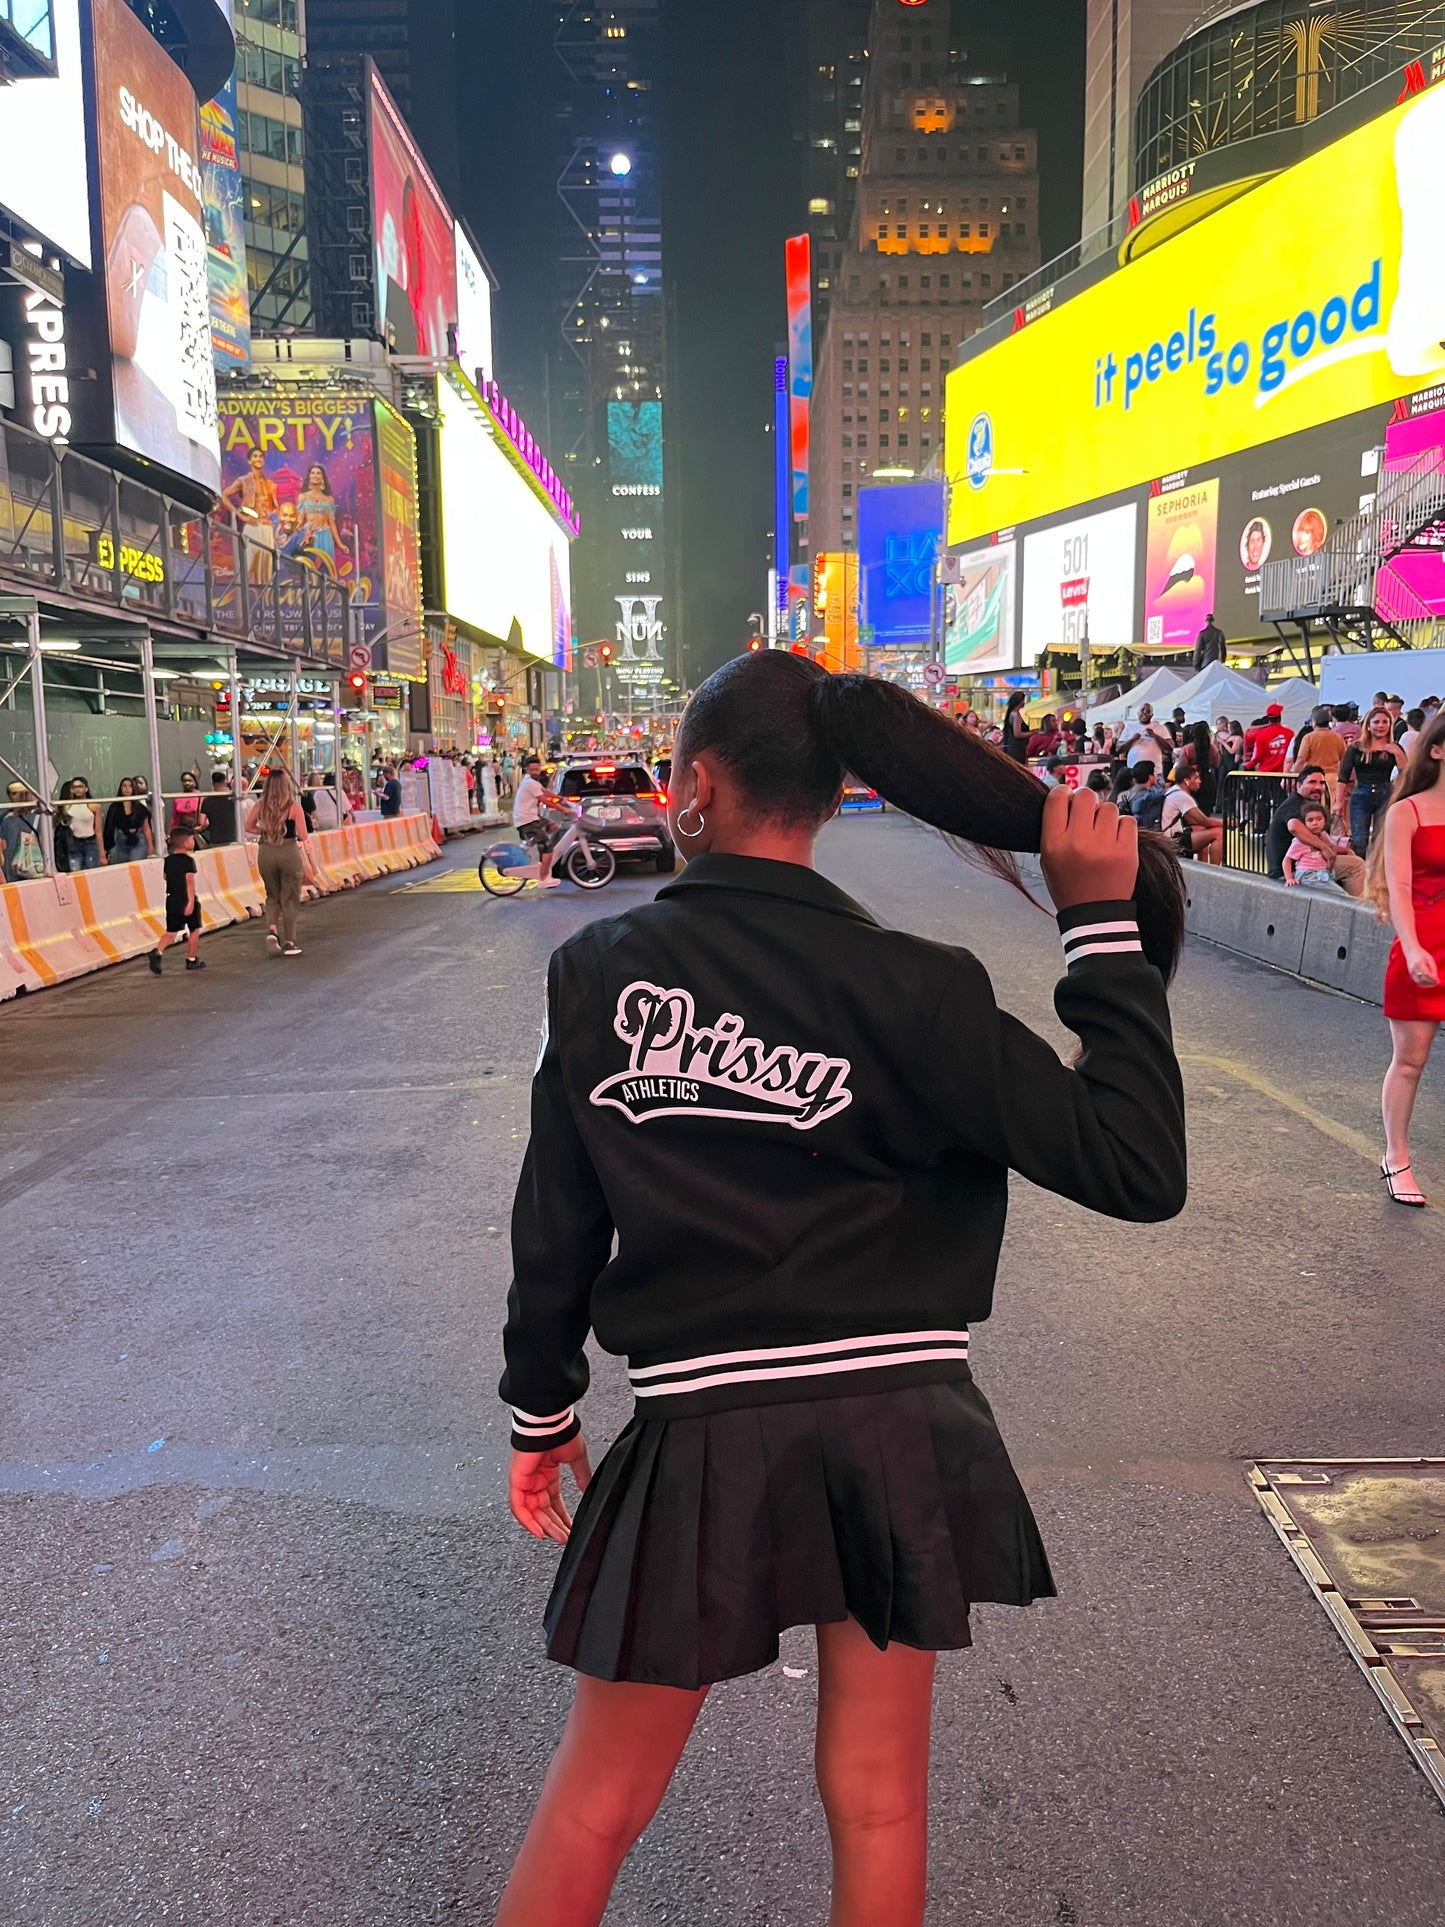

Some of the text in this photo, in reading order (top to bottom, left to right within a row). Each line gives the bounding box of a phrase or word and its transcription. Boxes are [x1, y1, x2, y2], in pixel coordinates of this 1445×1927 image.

[119, 85, 165, 155] SHOP
[165, 131, 194, 191] THE
[200, 119, 236, 158] TURE
[1142, 162, 1196, 201] MARRIOTT
[1142, 181, 1188, 216] MARQUIS
[1204, 256, 1382, 396] so good
[26, 292, 72, 446] PRES
[1095, 306, 1217, 412] it peels
[217, 399, 368, 416] ADWAY'S BIGGEST
[1411, 385, 1445, 405] MARRIO
[612, 484, 661, 496] CONFESS
[1251, 474, 1321, 502] Featuring Special Guests
[621, 528, 653, 540] YOUR
[1063, 533, 1089, 576] 501
[625, 571, 651, 583] SINS
[216, 610, 235, 619] THE
[615, 621, 664, 641] NUN
[620, 988, 847, 1123] Prissy
[621, 1078, 700, 1103] ATHLETICS
